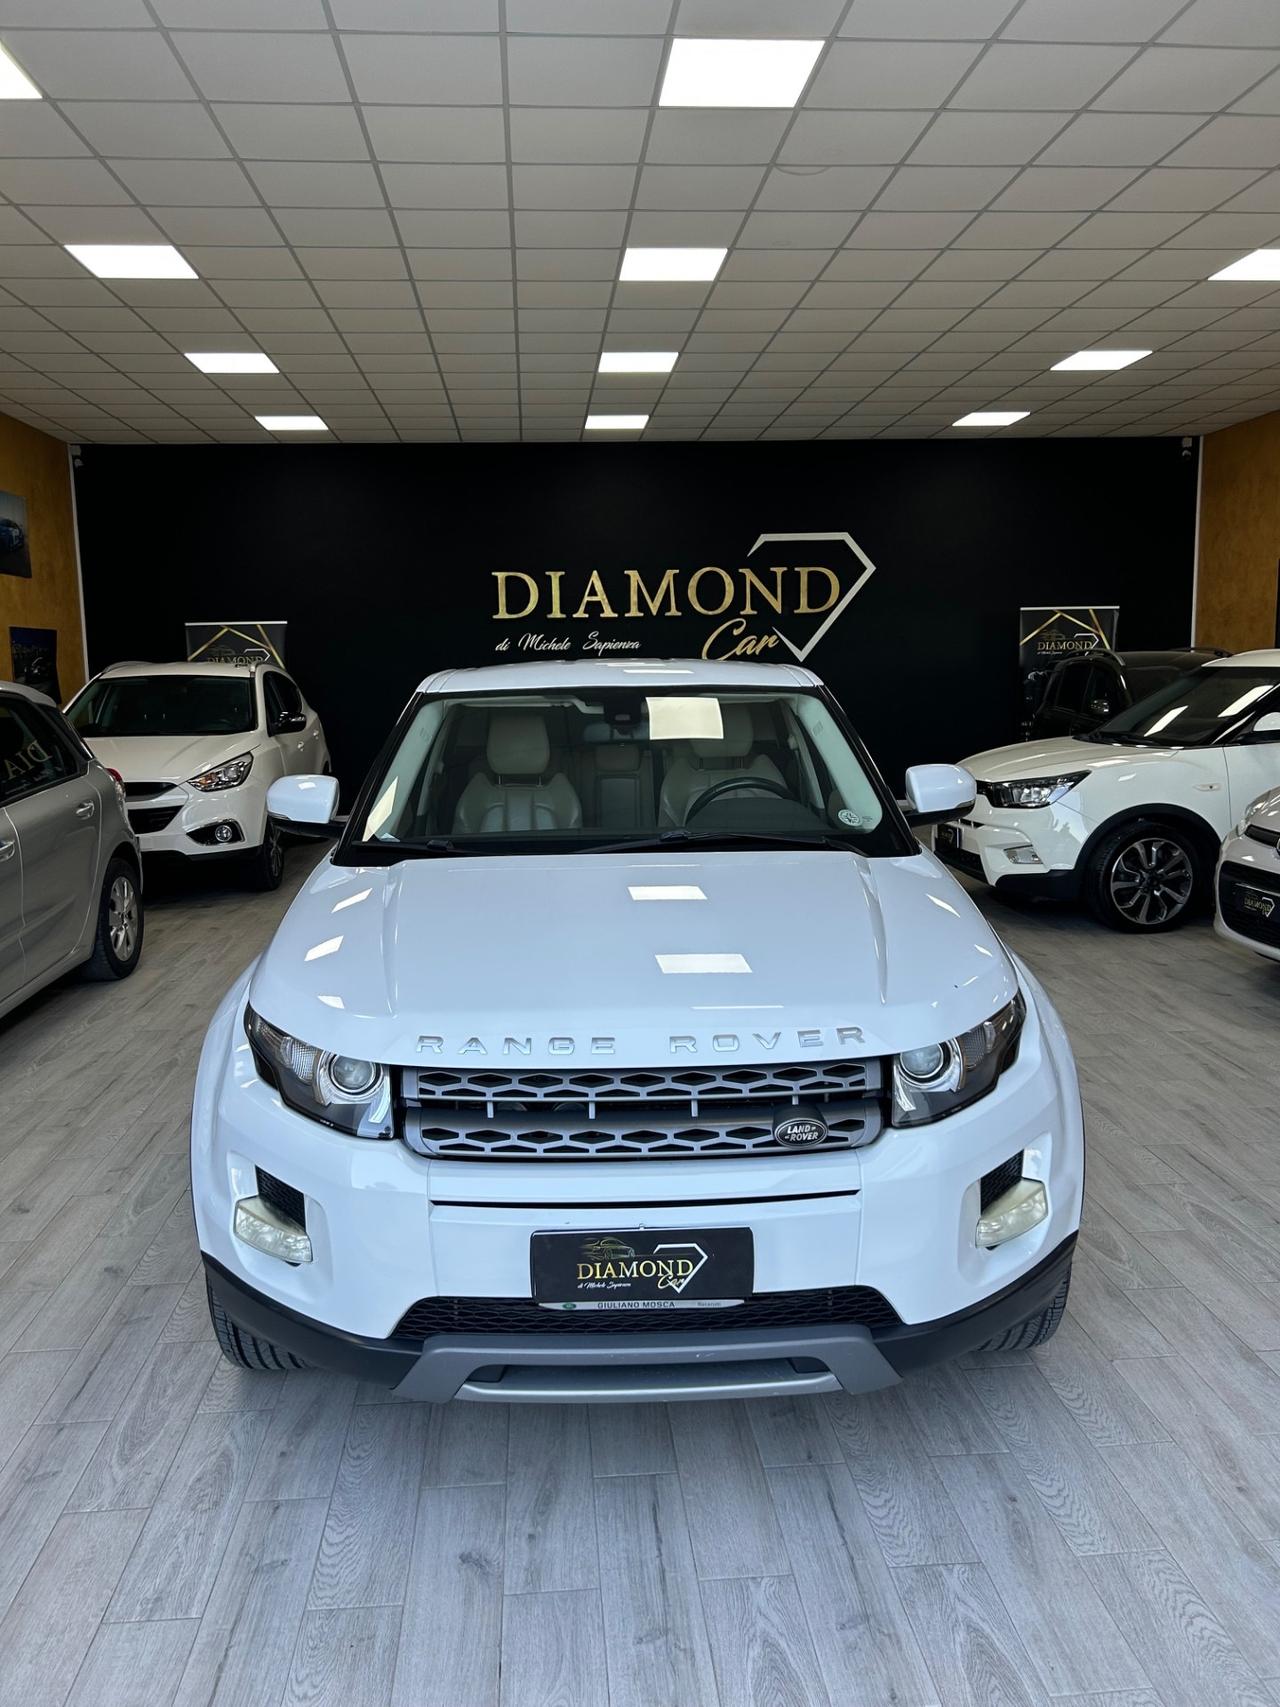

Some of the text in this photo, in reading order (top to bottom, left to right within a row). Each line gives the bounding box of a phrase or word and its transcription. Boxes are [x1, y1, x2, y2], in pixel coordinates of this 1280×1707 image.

[491, 566, 841, 619] DIAMOND
[495, 630, 641, 657] di Michele Sapienza
[701, 618, 780, 661] Car
[1037, 641, 1093, 650] DIAMOND
[415, 1026, 866, 1056] RANGE ROVER
[787, 1125, 811, 1133] LAND
[790, 1132, 818, 1141] ROVER
[576, 1259, 694, 1280] DIAMOND
[597, 1300, 676, 1309] GIULIANO MOSCA
